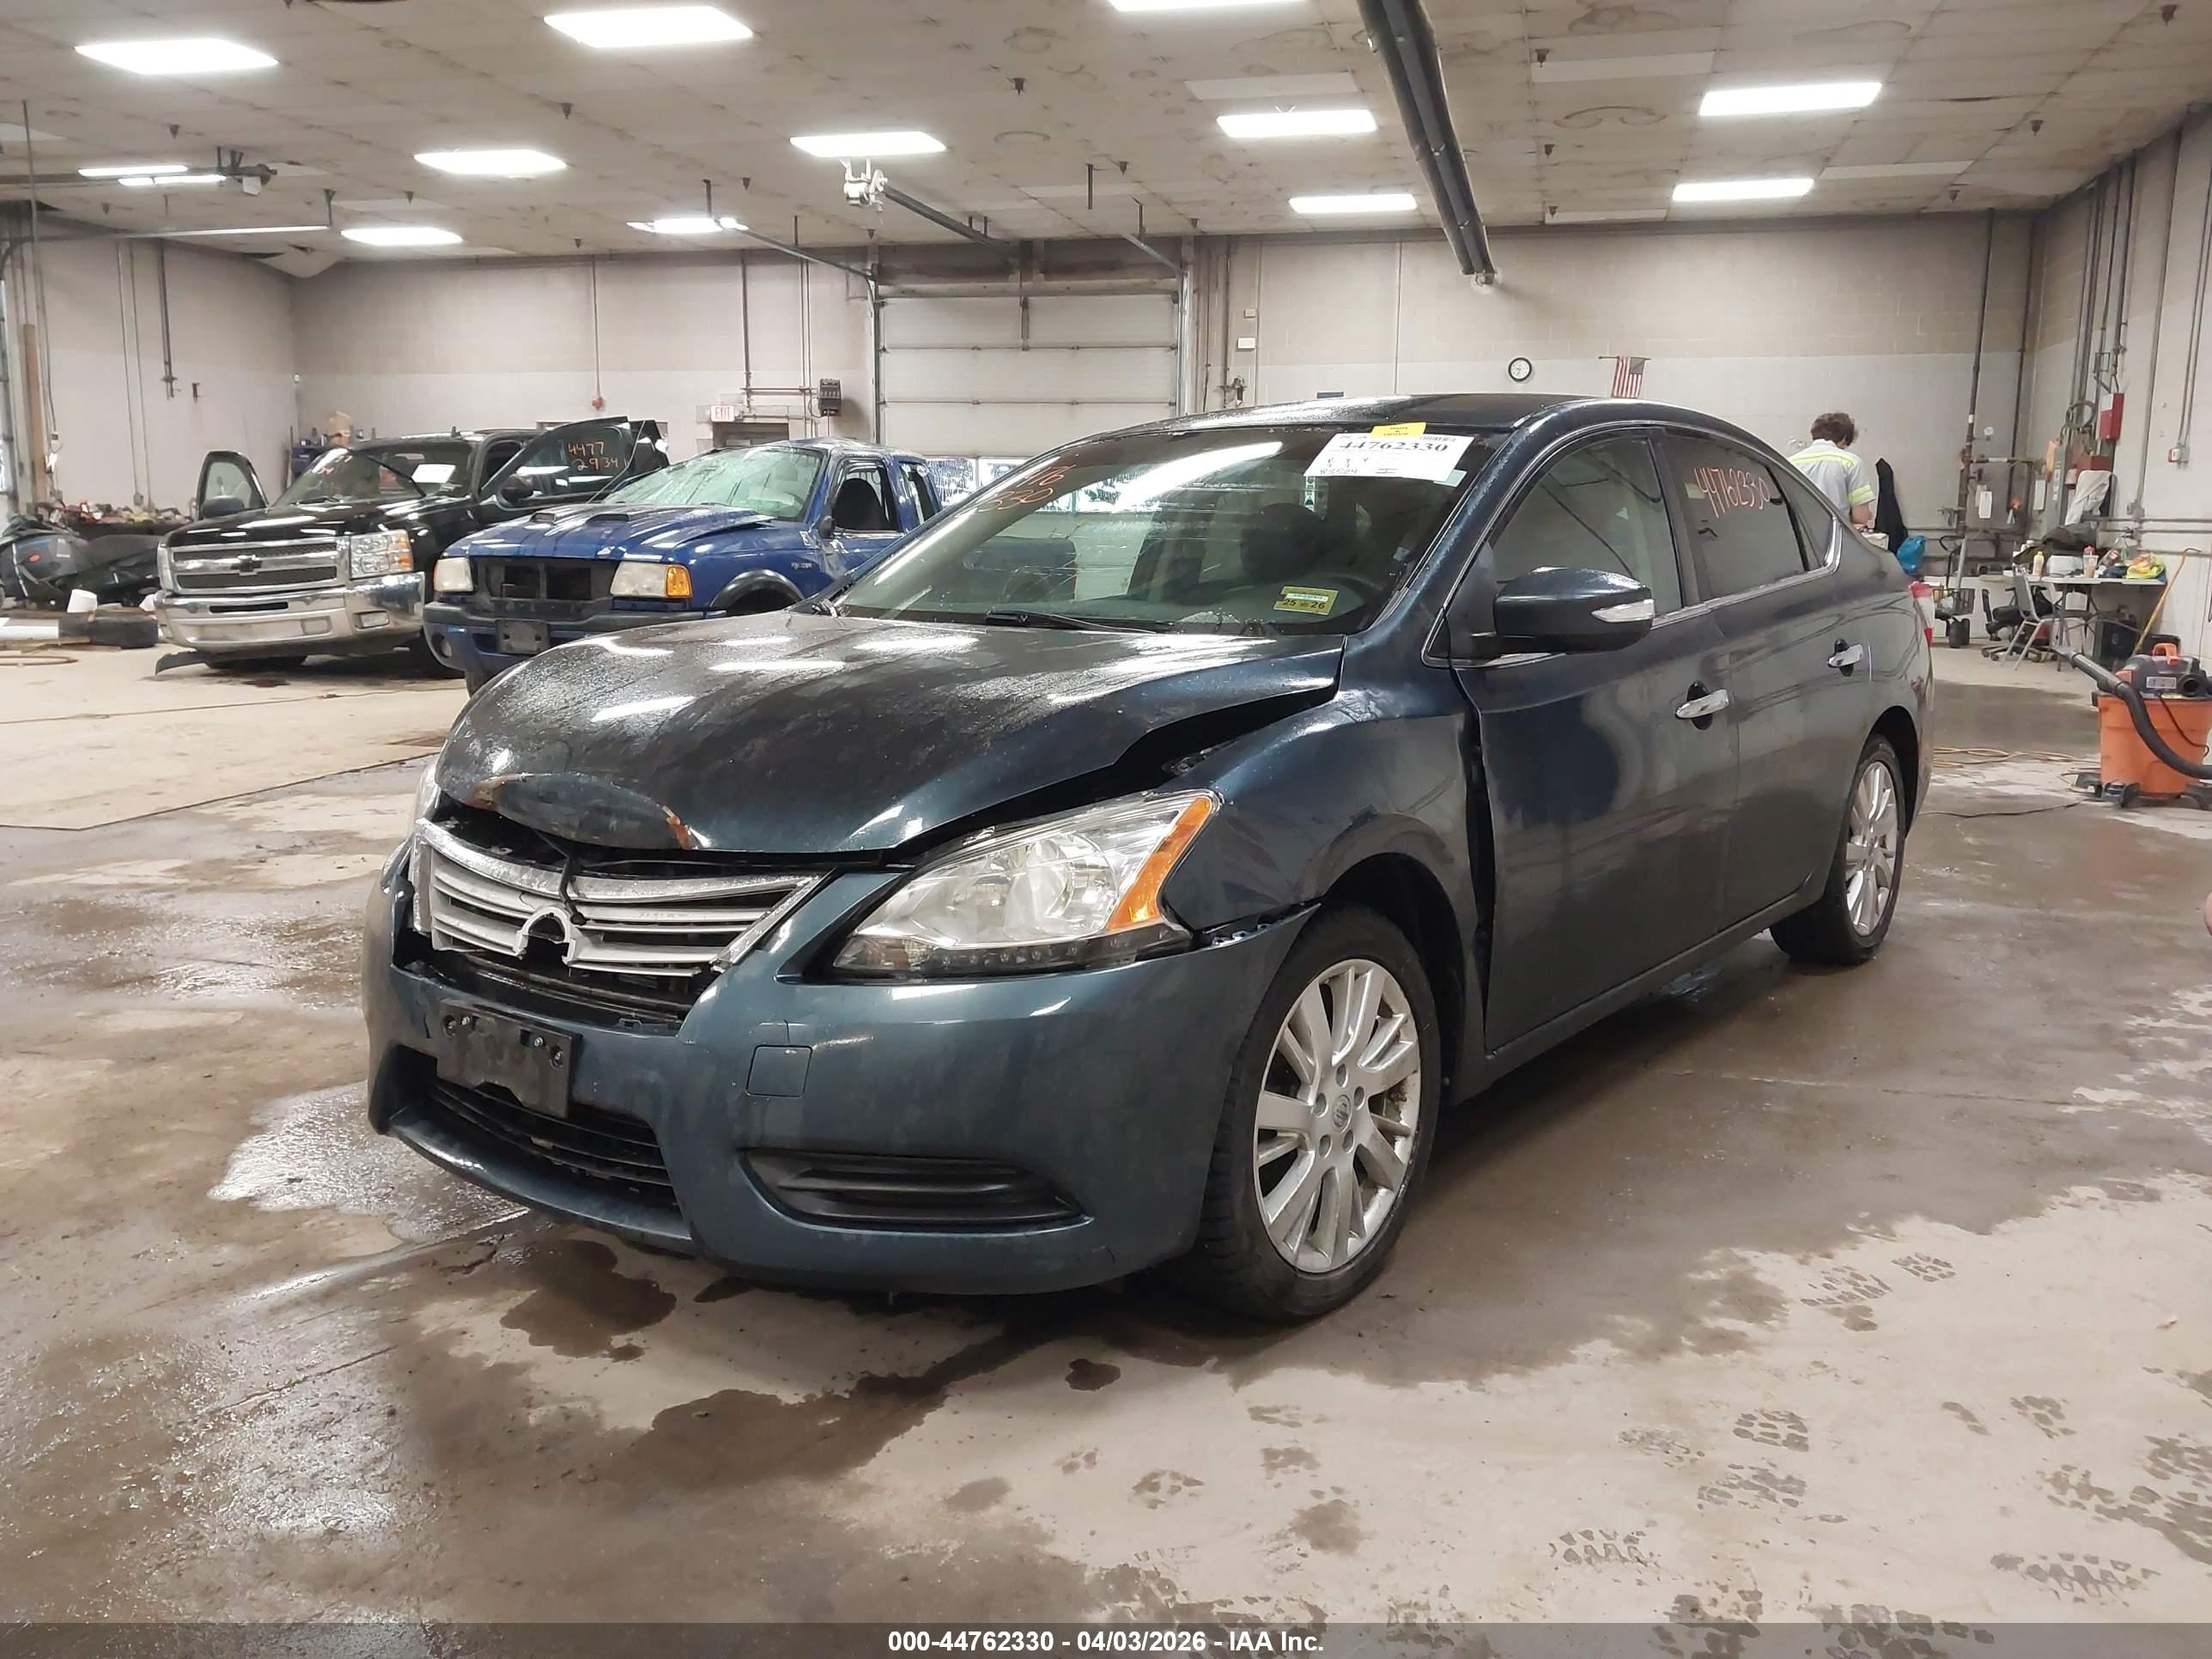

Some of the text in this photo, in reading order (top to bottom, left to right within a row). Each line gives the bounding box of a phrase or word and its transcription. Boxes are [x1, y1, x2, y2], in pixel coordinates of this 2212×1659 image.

[714, 406, 731, 420] EXIT
[568, 440, 605, 457] 4477
[1339, 441, 1449, 453] 44762330
[1310, 601, 1326, 610] 26
